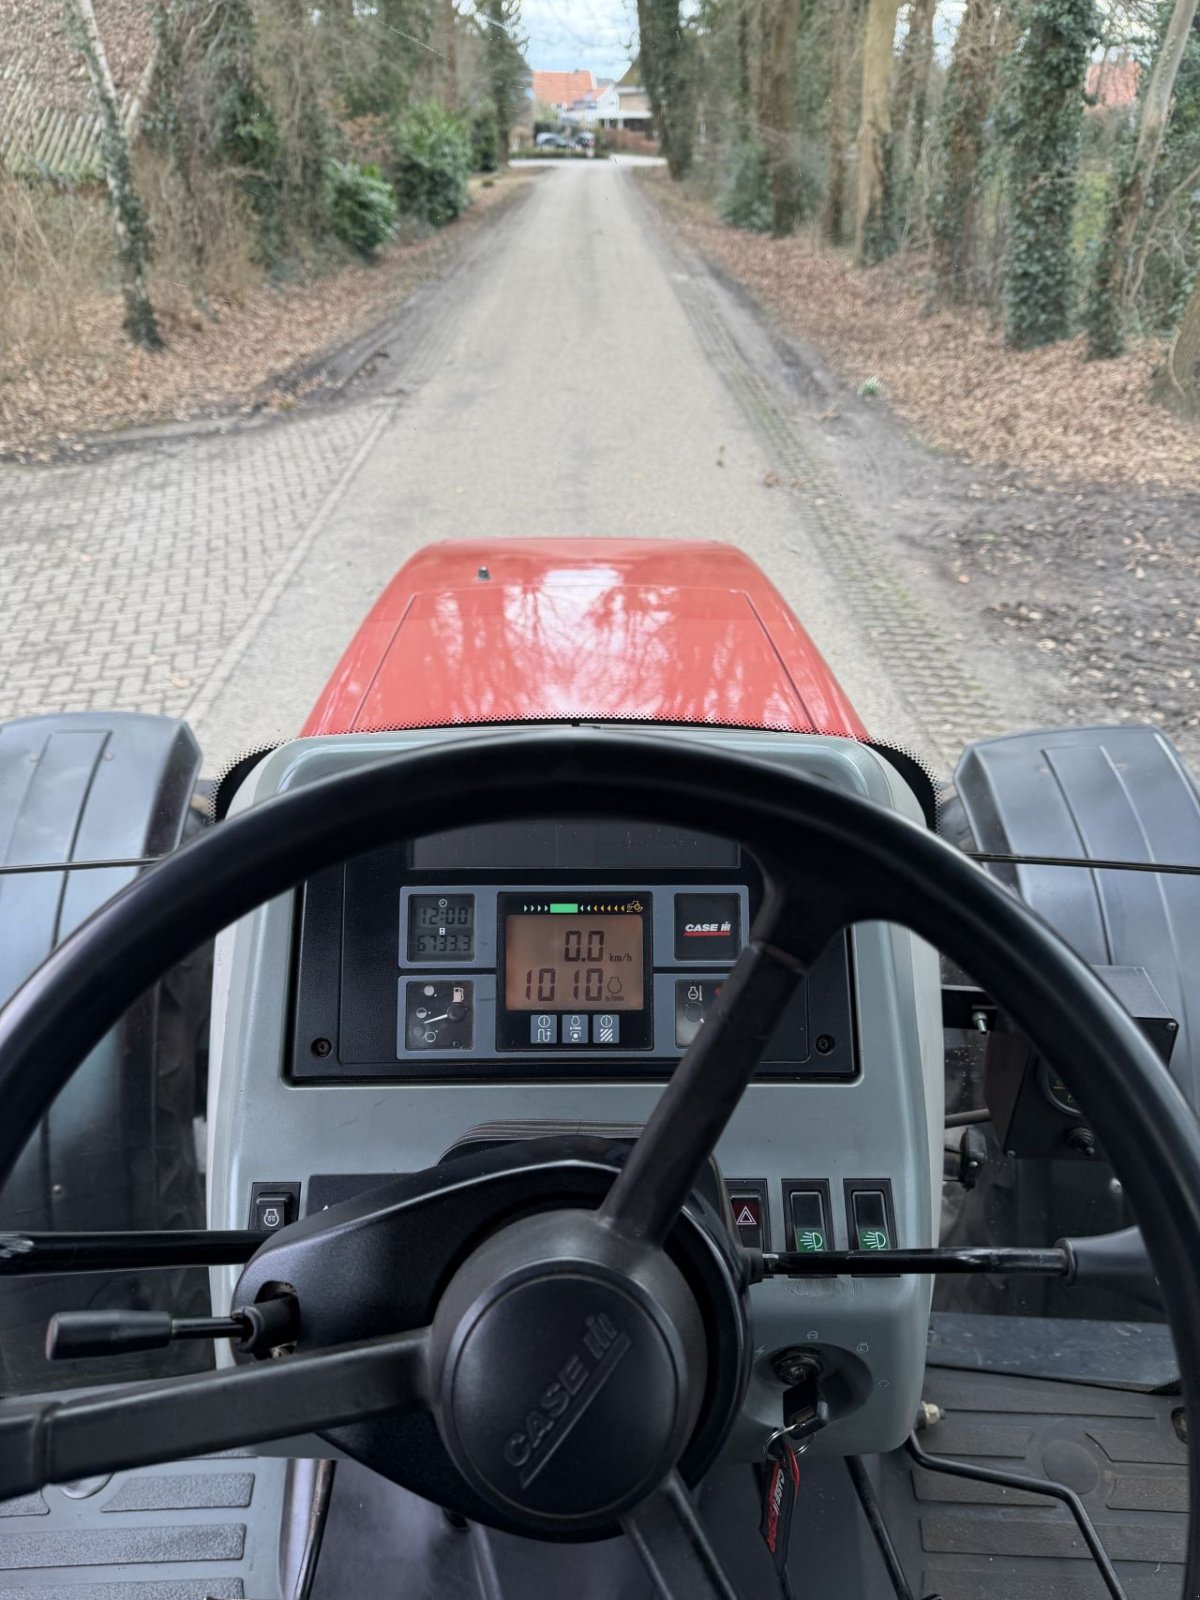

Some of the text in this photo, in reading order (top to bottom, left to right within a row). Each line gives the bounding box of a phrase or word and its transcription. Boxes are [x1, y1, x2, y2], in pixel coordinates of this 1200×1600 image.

[422, 907, 468, 925] 12:00
[685, 923, 719, 932] CASE
[564, 930, 632, 962] 0.0 km/h
[525, 968, 604, 1001] 1010
[504, 1355, 589, 1467] CASE
